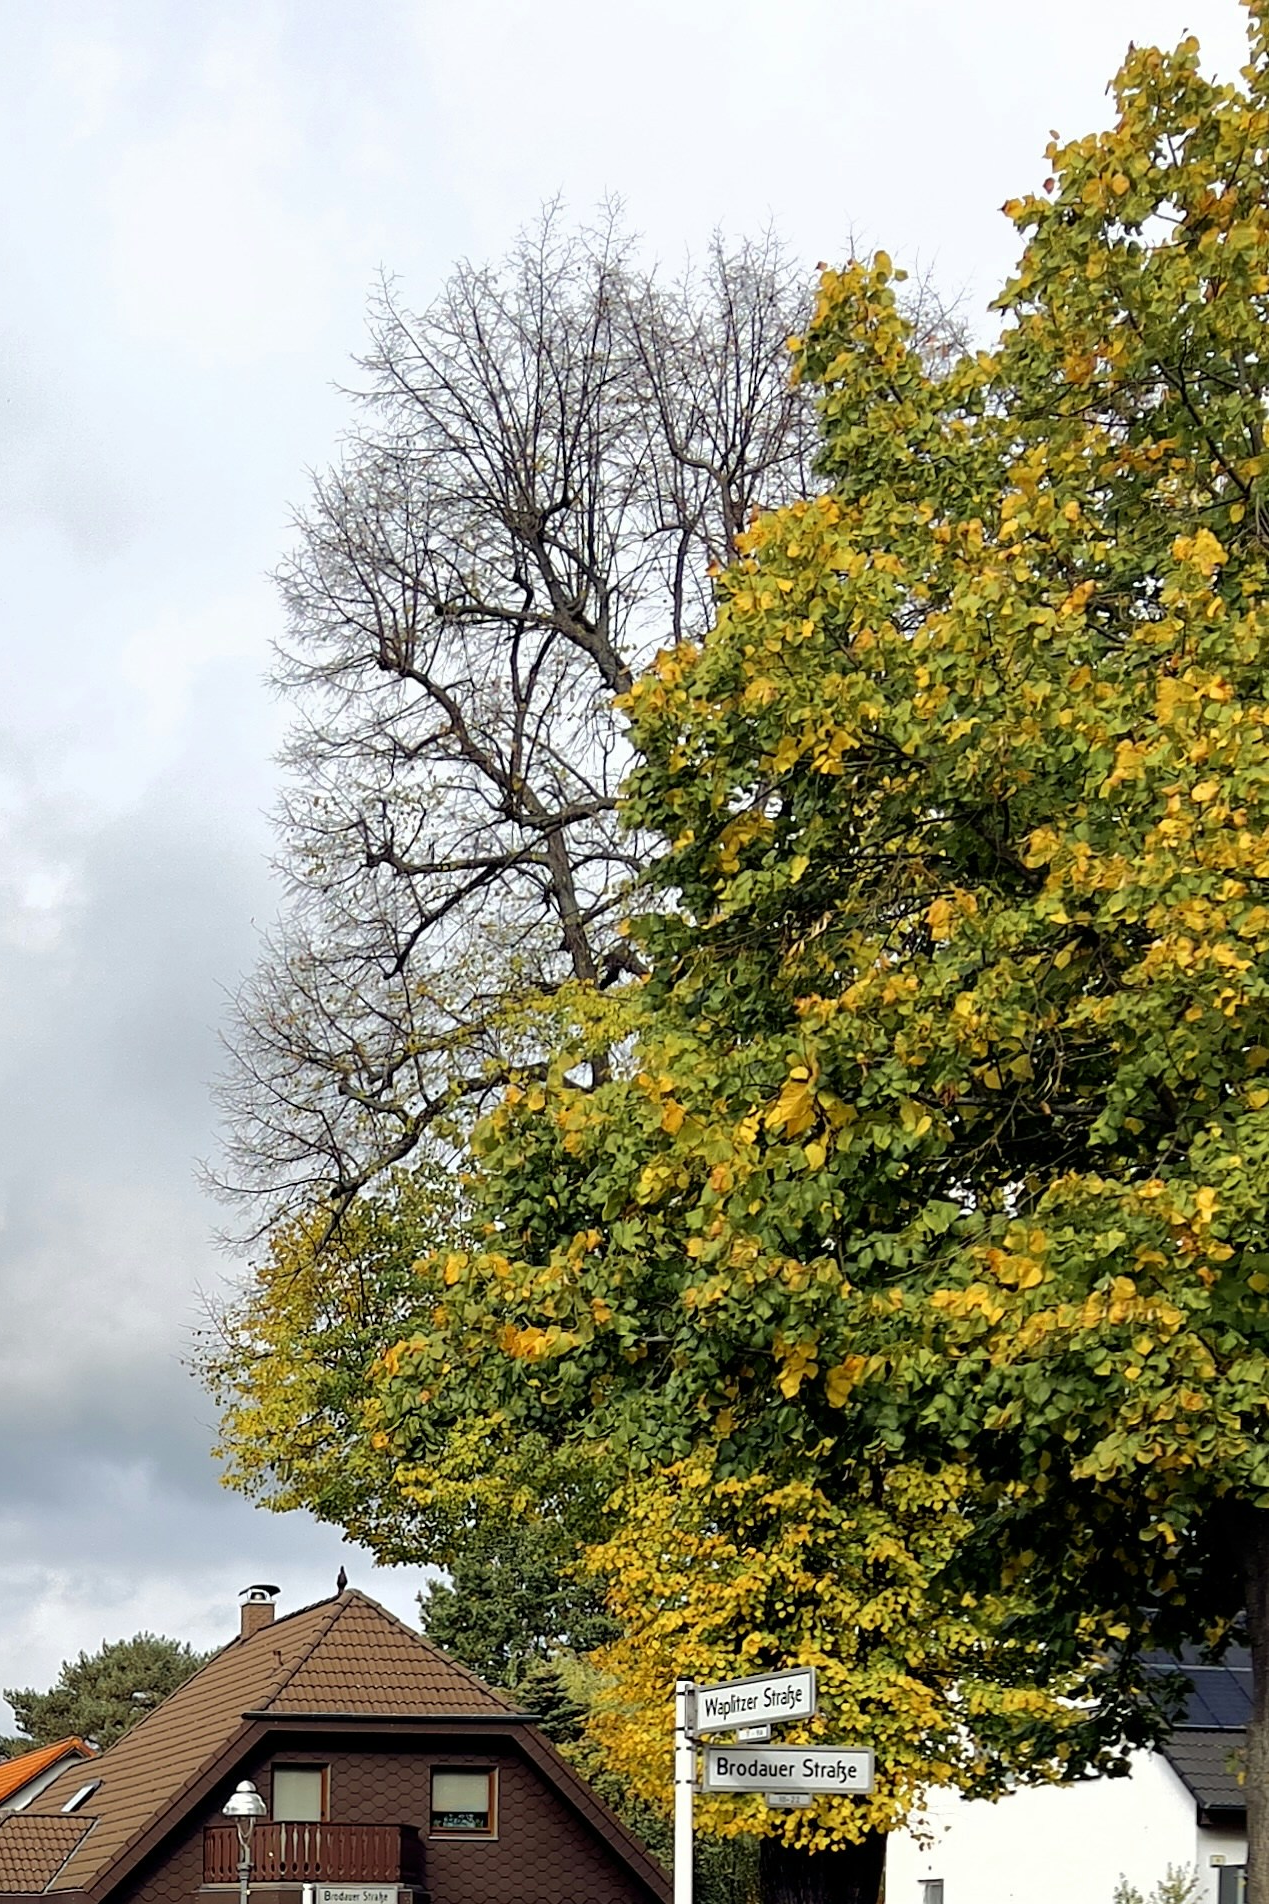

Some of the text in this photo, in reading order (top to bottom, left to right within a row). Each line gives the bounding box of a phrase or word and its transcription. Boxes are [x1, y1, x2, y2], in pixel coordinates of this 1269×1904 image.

[705, 1685, 803, 1720] Waplitzer Straße
[716, 1757, 857, 1783] Brodauer Straße
[324, 1890, 388, 1904] Brodauer Straße
